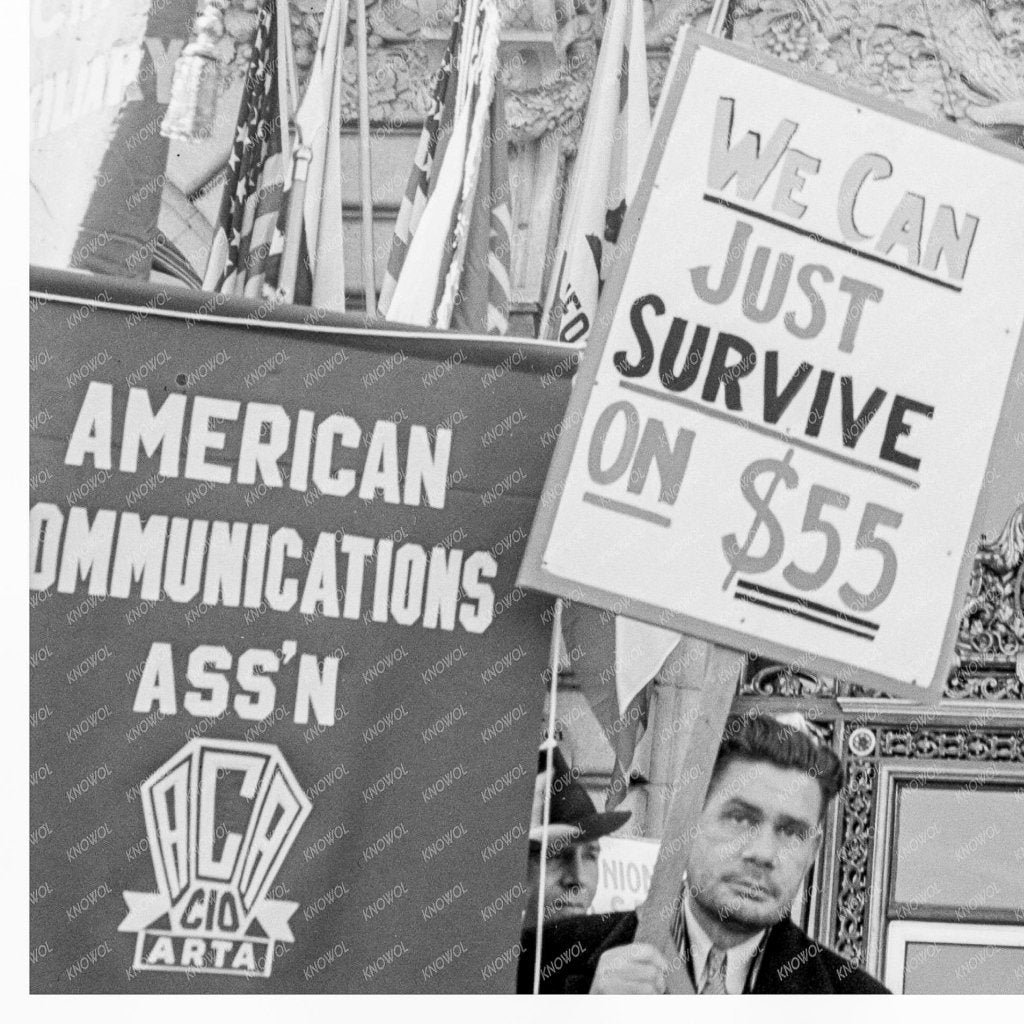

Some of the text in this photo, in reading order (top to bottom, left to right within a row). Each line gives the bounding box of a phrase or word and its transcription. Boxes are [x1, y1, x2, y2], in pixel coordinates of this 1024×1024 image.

[704, 95, 980, 280] WE CAN
[689, 220, 884, 354] JUST
[64, 381, 452, 509] AMERICAN
[613, 293, 935, 472] SURVIVE
[587, 400, 697, 506] ON
[29, 501, 498, 634] OMMUNICATIONS
[720, 448, 905, 614] $55
[133, 640, 340, 727] ASS'N
[149, 936, 256, 971] ARTA
[180, 887, 240, 933] CIO
